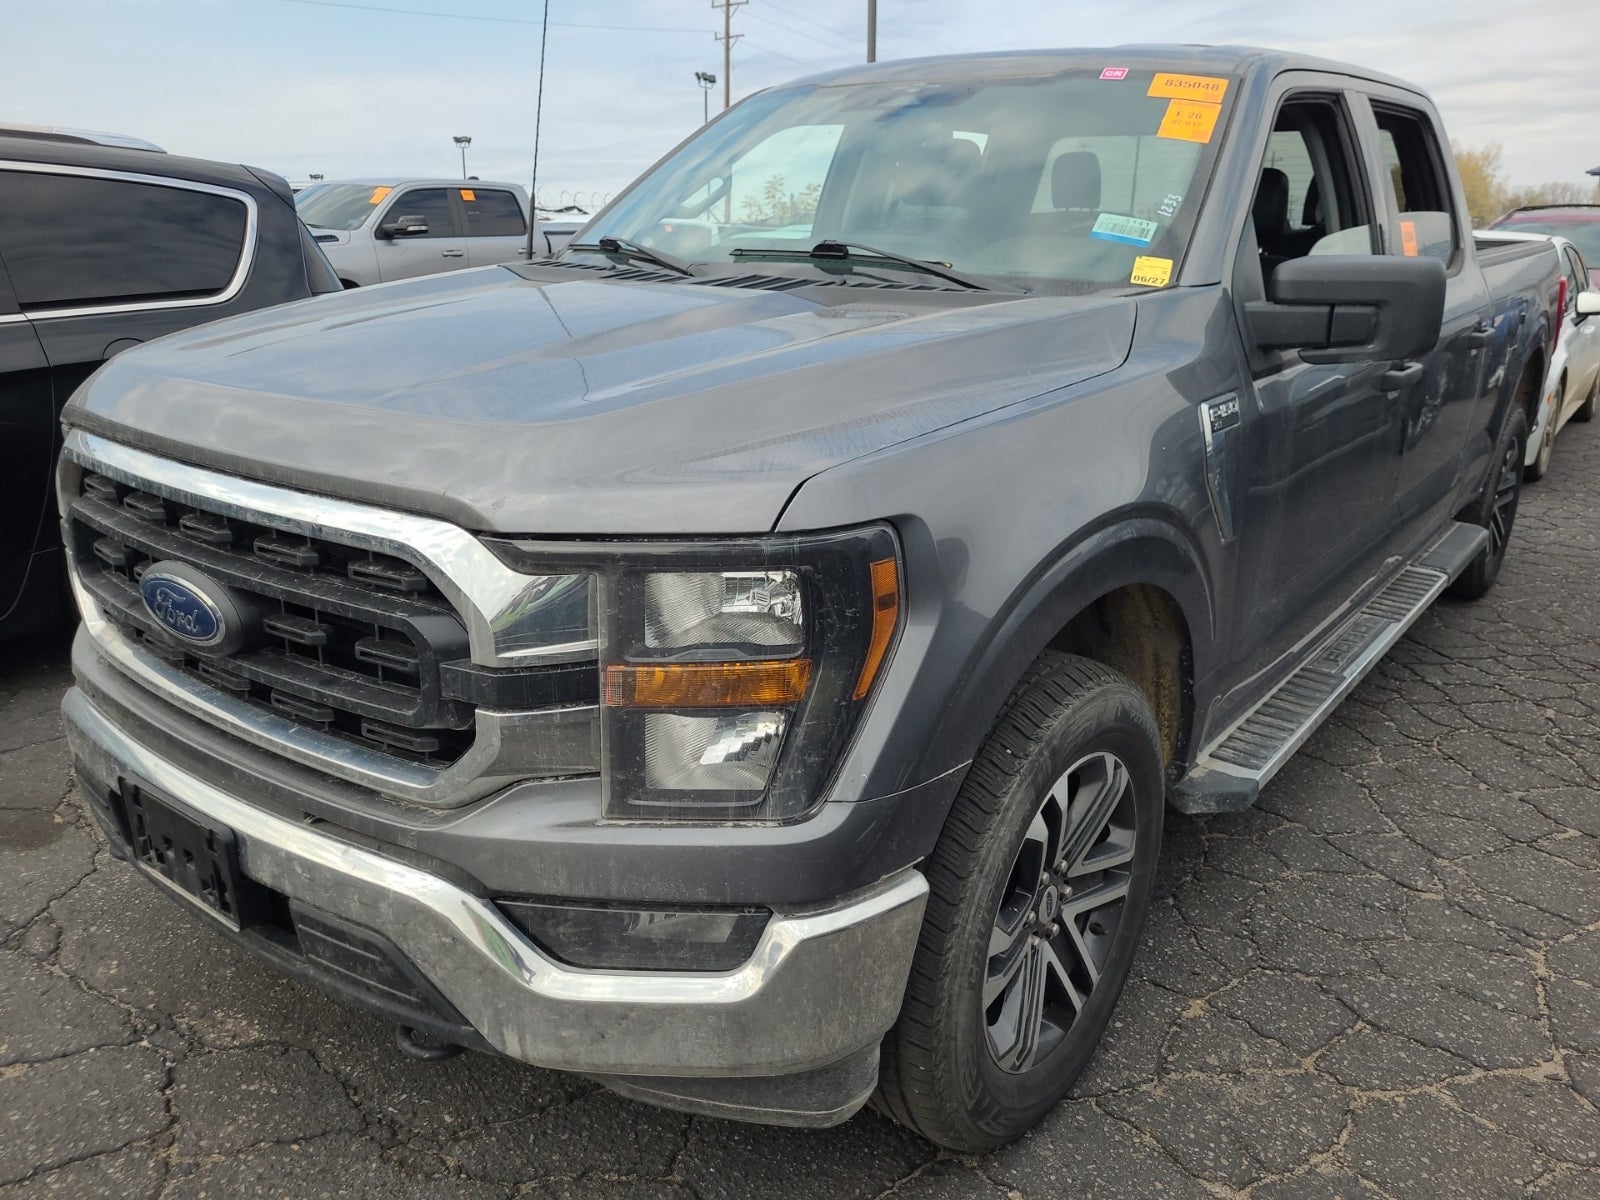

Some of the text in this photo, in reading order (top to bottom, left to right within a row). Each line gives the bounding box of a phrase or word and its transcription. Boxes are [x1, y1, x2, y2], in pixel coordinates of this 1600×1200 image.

[1164, 79, 1220, 91] 835048
[1157, 194, 1182, 217] 1233
[1133, 275, 1166, 285] 06/27
[154, 586, 200, 633] Ford
